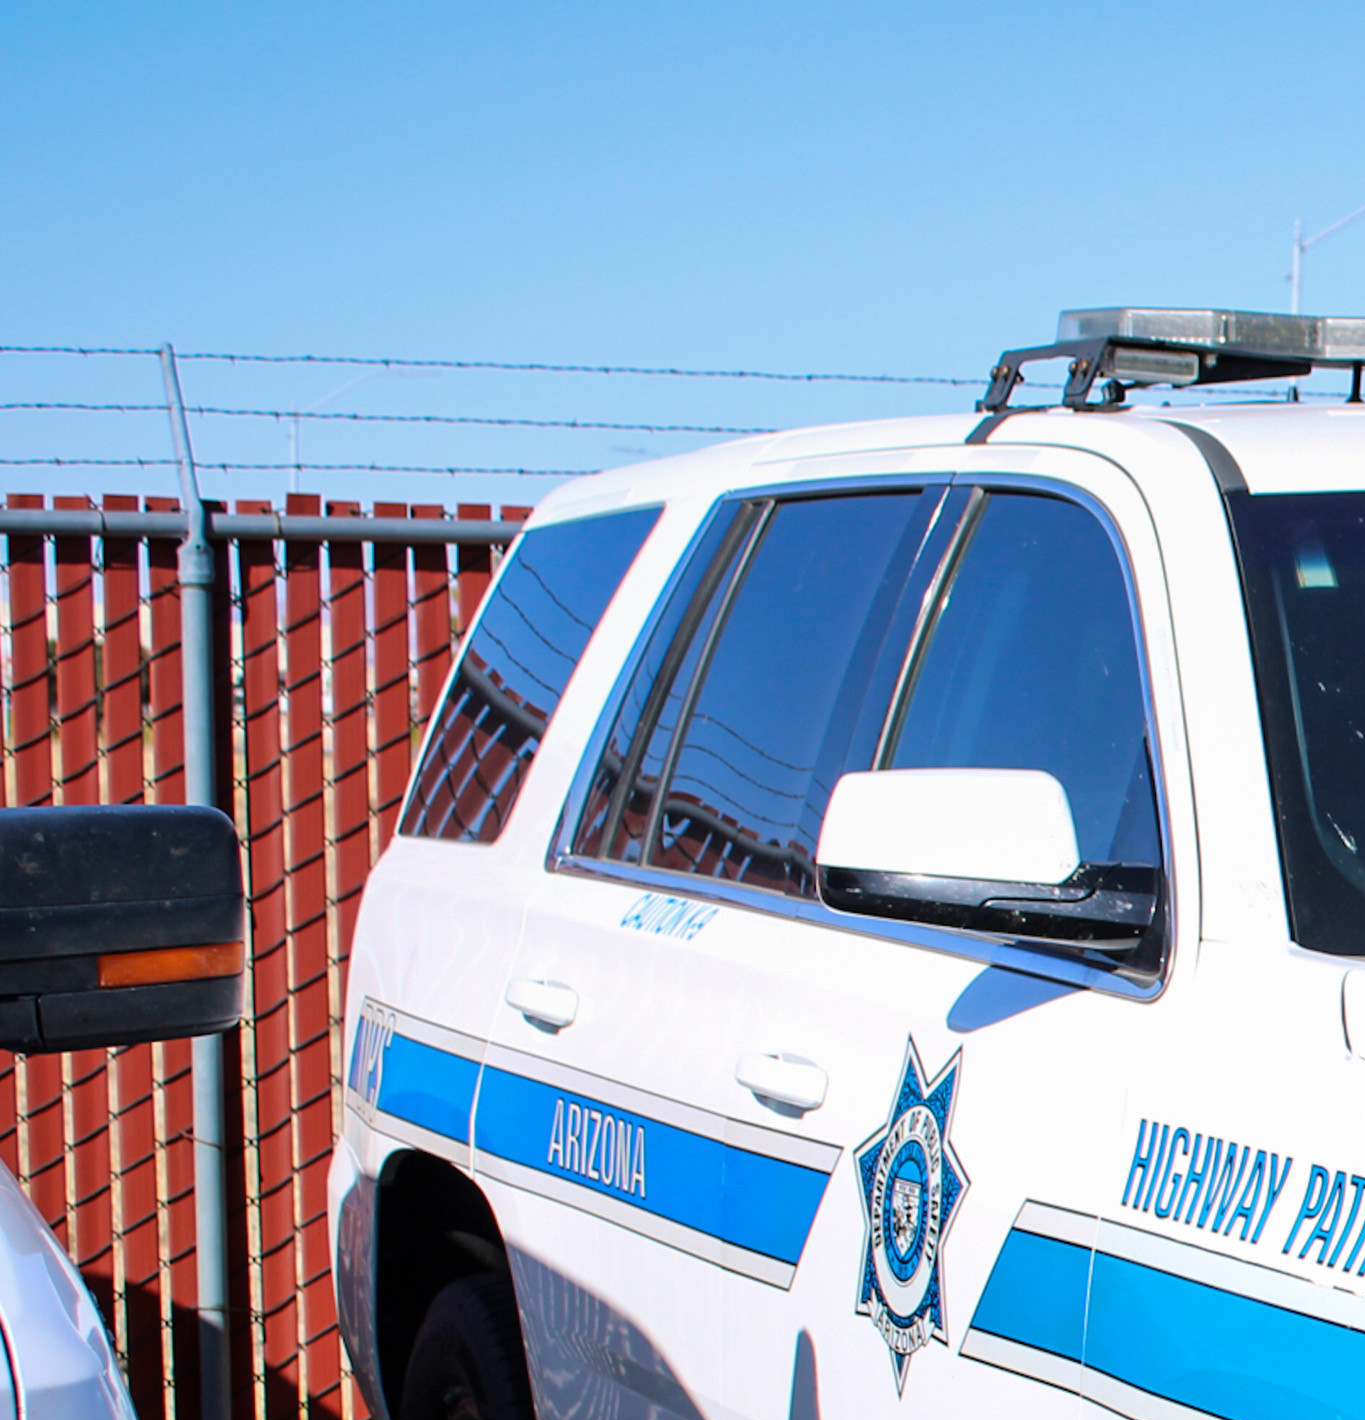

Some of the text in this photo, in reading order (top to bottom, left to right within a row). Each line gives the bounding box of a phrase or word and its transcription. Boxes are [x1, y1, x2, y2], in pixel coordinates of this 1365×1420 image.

[547, 1098, 646, 1200] ARIZONA
[873, 1110, 940, 1262] DEPARTMENT OF PUBLIC SAFETY
[1121, 1118, 1293, 1245] HIGHWAY
[878, 1308, 925, 1352] ARIZONA
